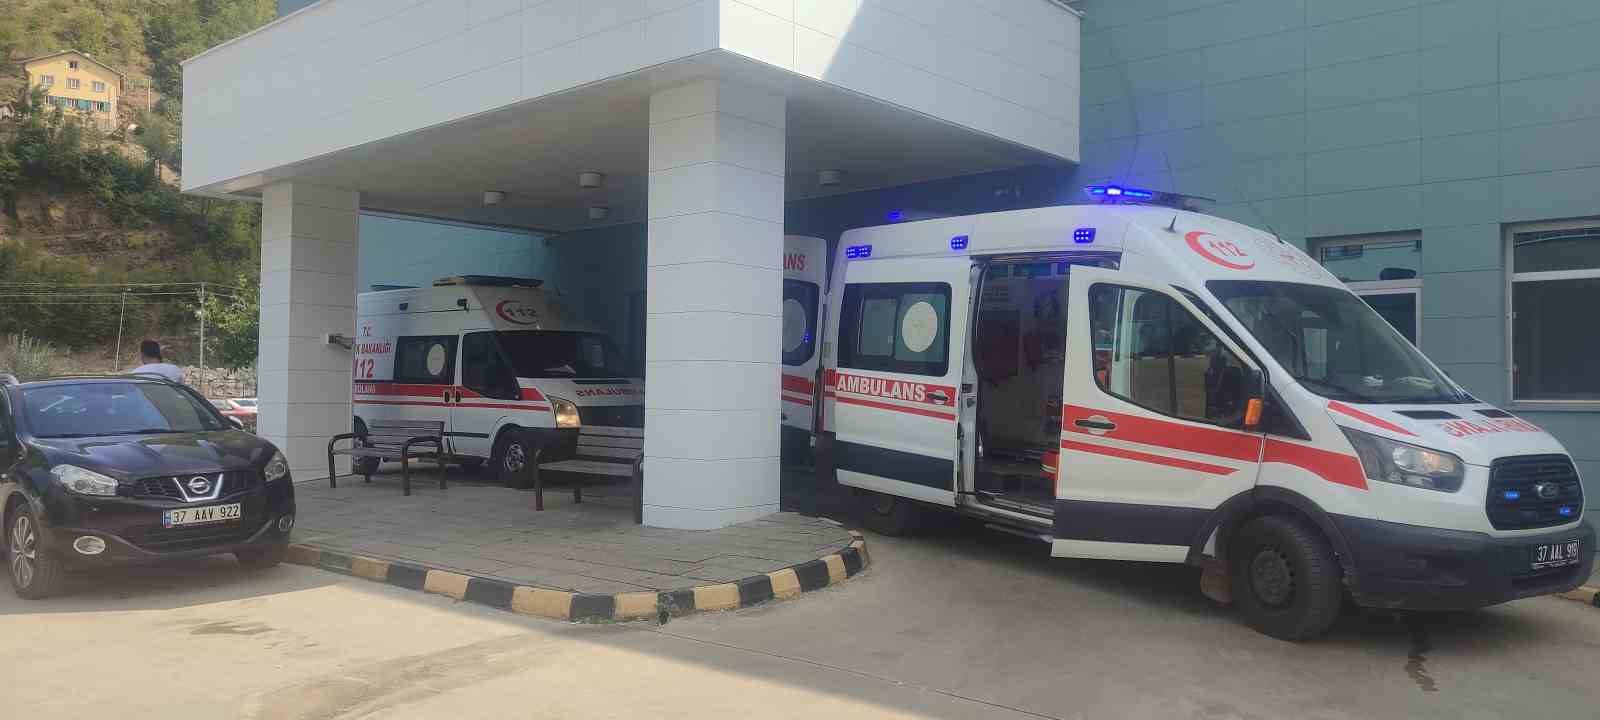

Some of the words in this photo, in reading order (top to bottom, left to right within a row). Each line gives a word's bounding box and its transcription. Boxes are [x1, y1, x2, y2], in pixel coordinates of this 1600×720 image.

[1209, 240, 1248, 256] 112
[505, 306, 538, 317] 112
[837, 375, 926, 401] AMBULANS
[174, 511, 186, 523] 37
[194, 508, 214, 521] AAV
[220, 505, 239, 517] 922
[1537, 545, 1548, 561] 37
[1550, 544, 1563, 561] AAL
